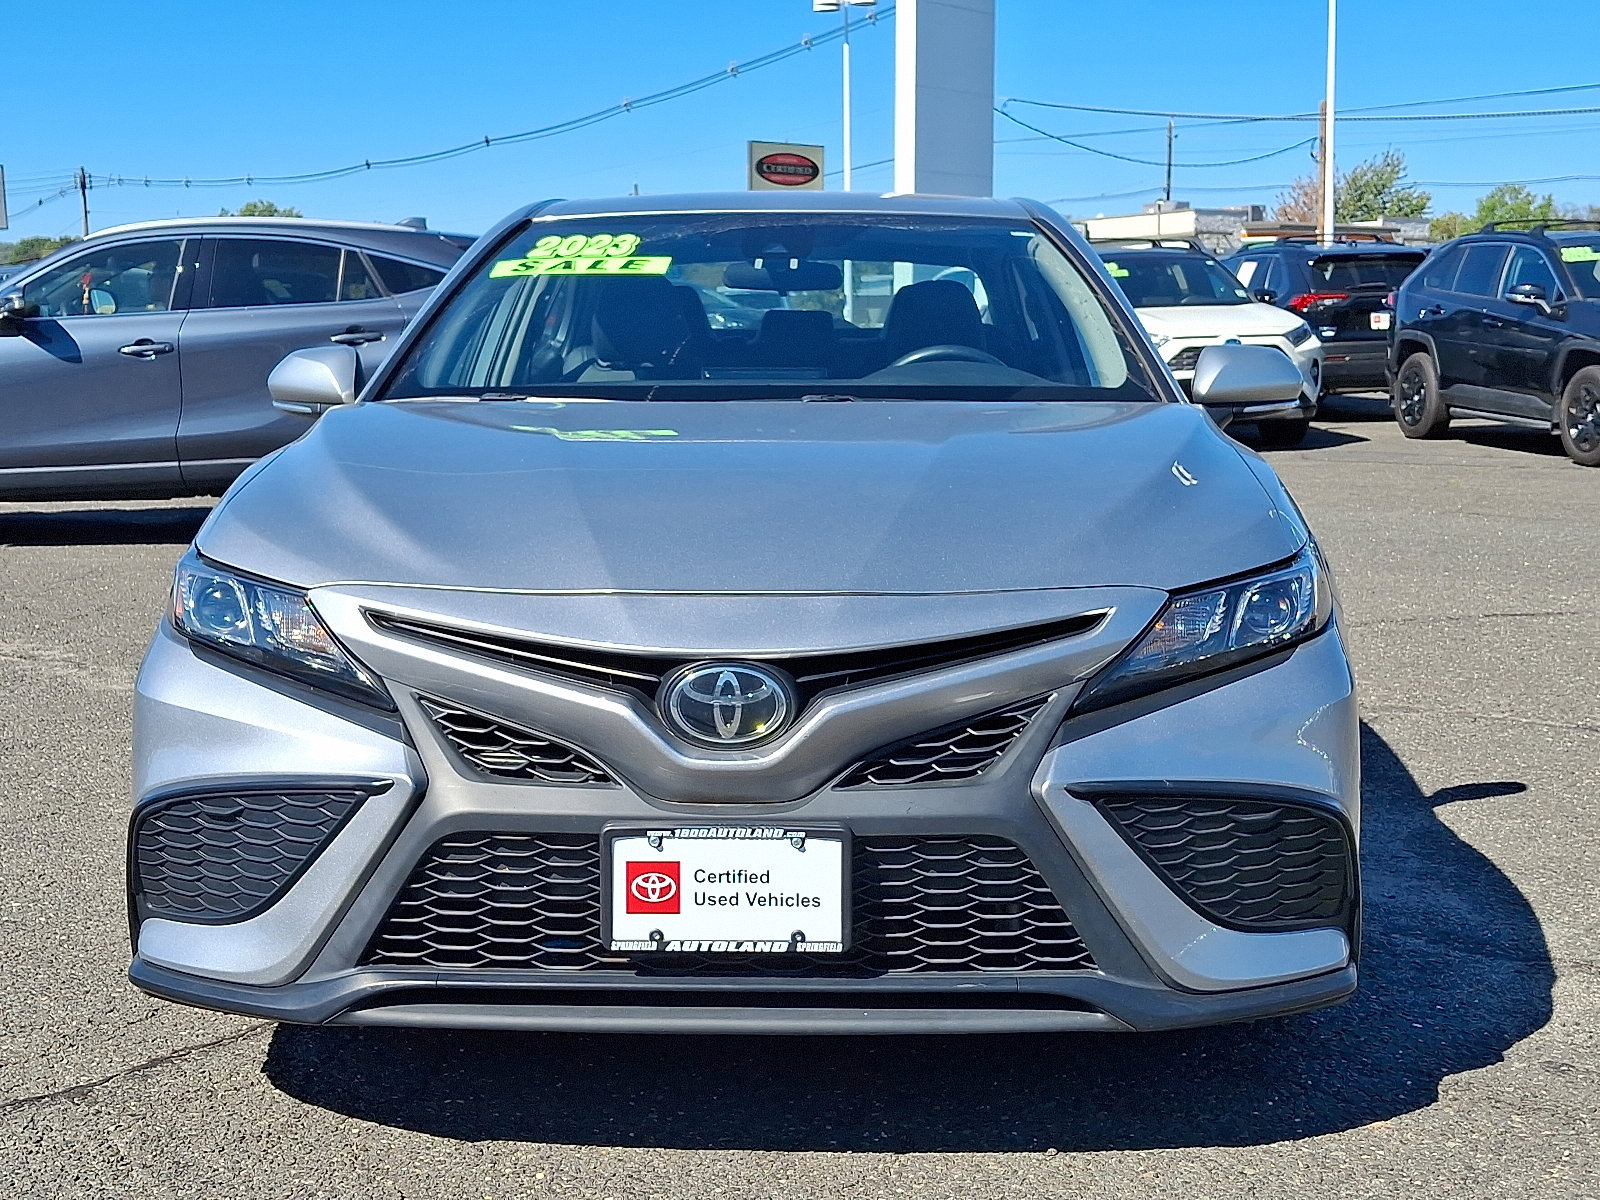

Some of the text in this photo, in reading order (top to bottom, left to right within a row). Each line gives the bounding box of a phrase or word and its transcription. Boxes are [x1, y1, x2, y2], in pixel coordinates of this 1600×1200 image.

[526, 233, 641, 258] 2023
[510, 259, 651, 272] SALE
[693, 868, 770, 884] Certified
[693, 891, 821, 908] Used Vehicles
[664, 940, 790, 952] AUTOLAND
